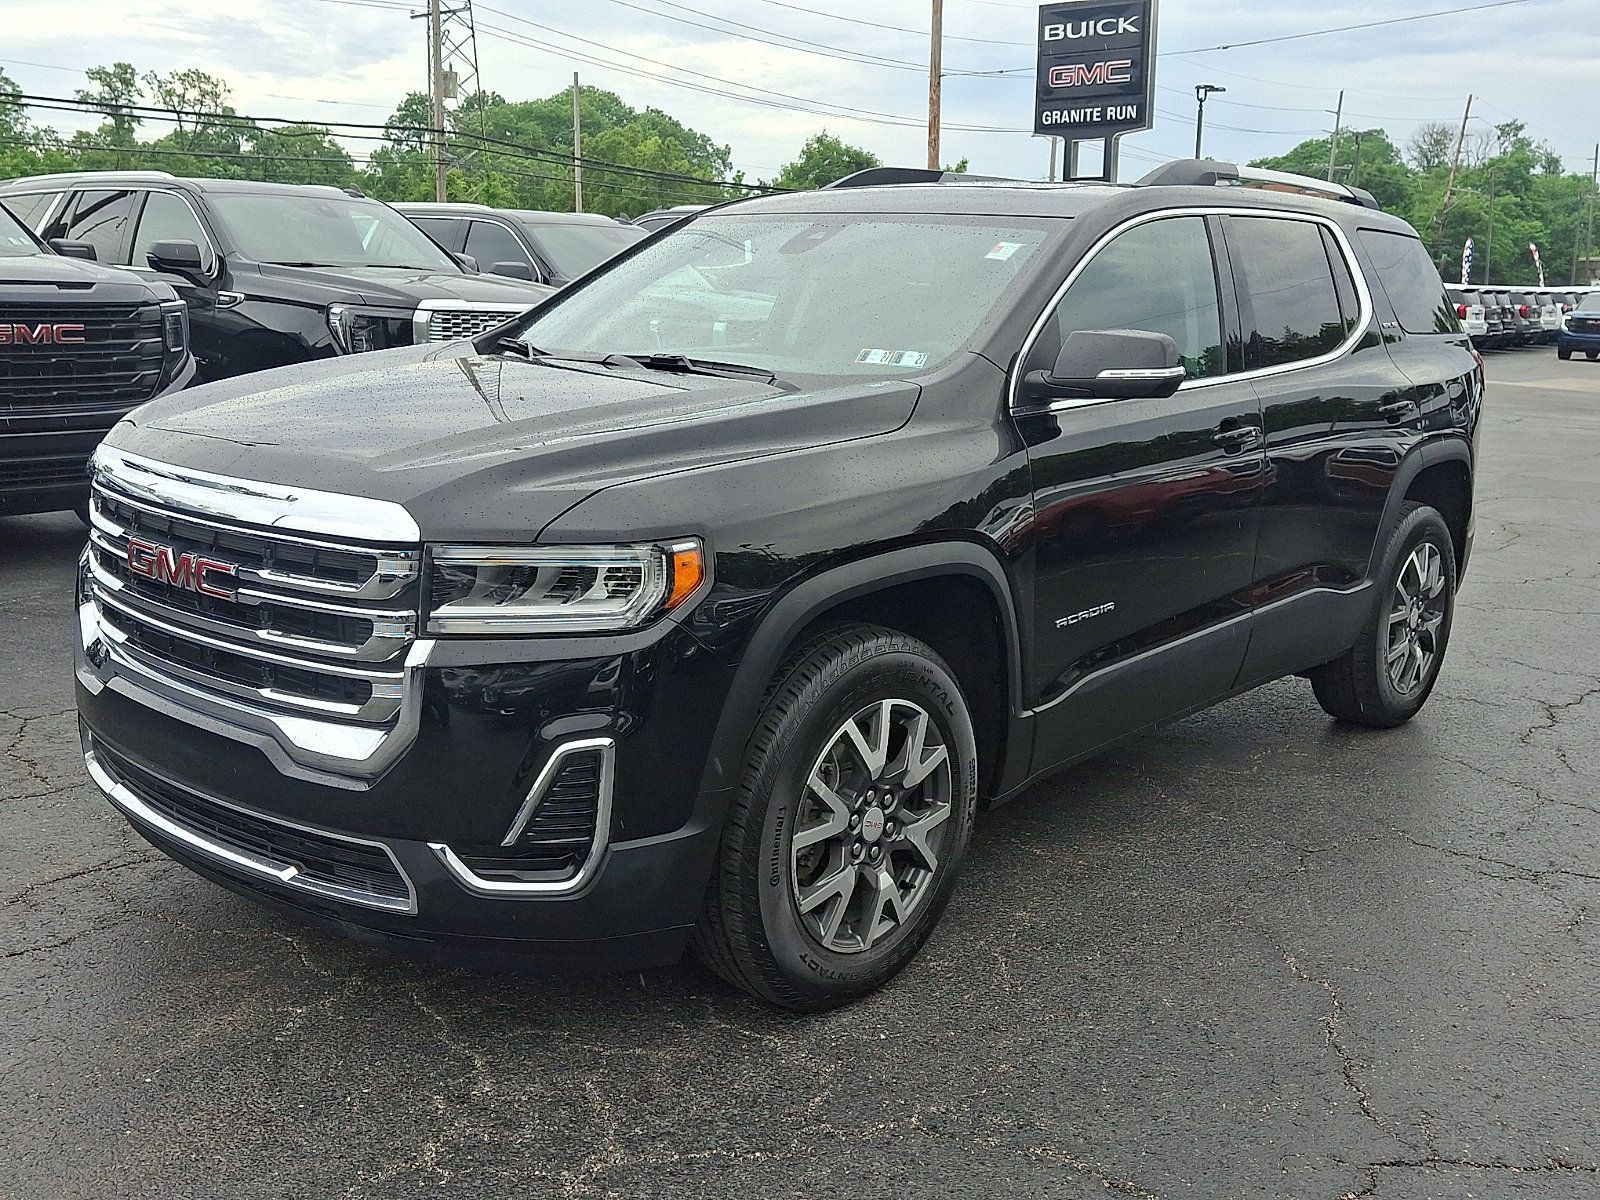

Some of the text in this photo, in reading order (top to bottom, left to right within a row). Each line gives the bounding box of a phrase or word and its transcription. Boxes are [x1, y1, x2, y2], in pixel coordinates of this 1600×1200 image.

[1044, 15, 1140, 41] BUICK
[1049, 59, 1132, 88] GMC
[1042, 105, 1137, 125] GRANITE RUN
[127, 537, 239, 603] GMC
[1054, 602, 1115, 629] ACADIA
[769, 813, 785, 888] Continental
